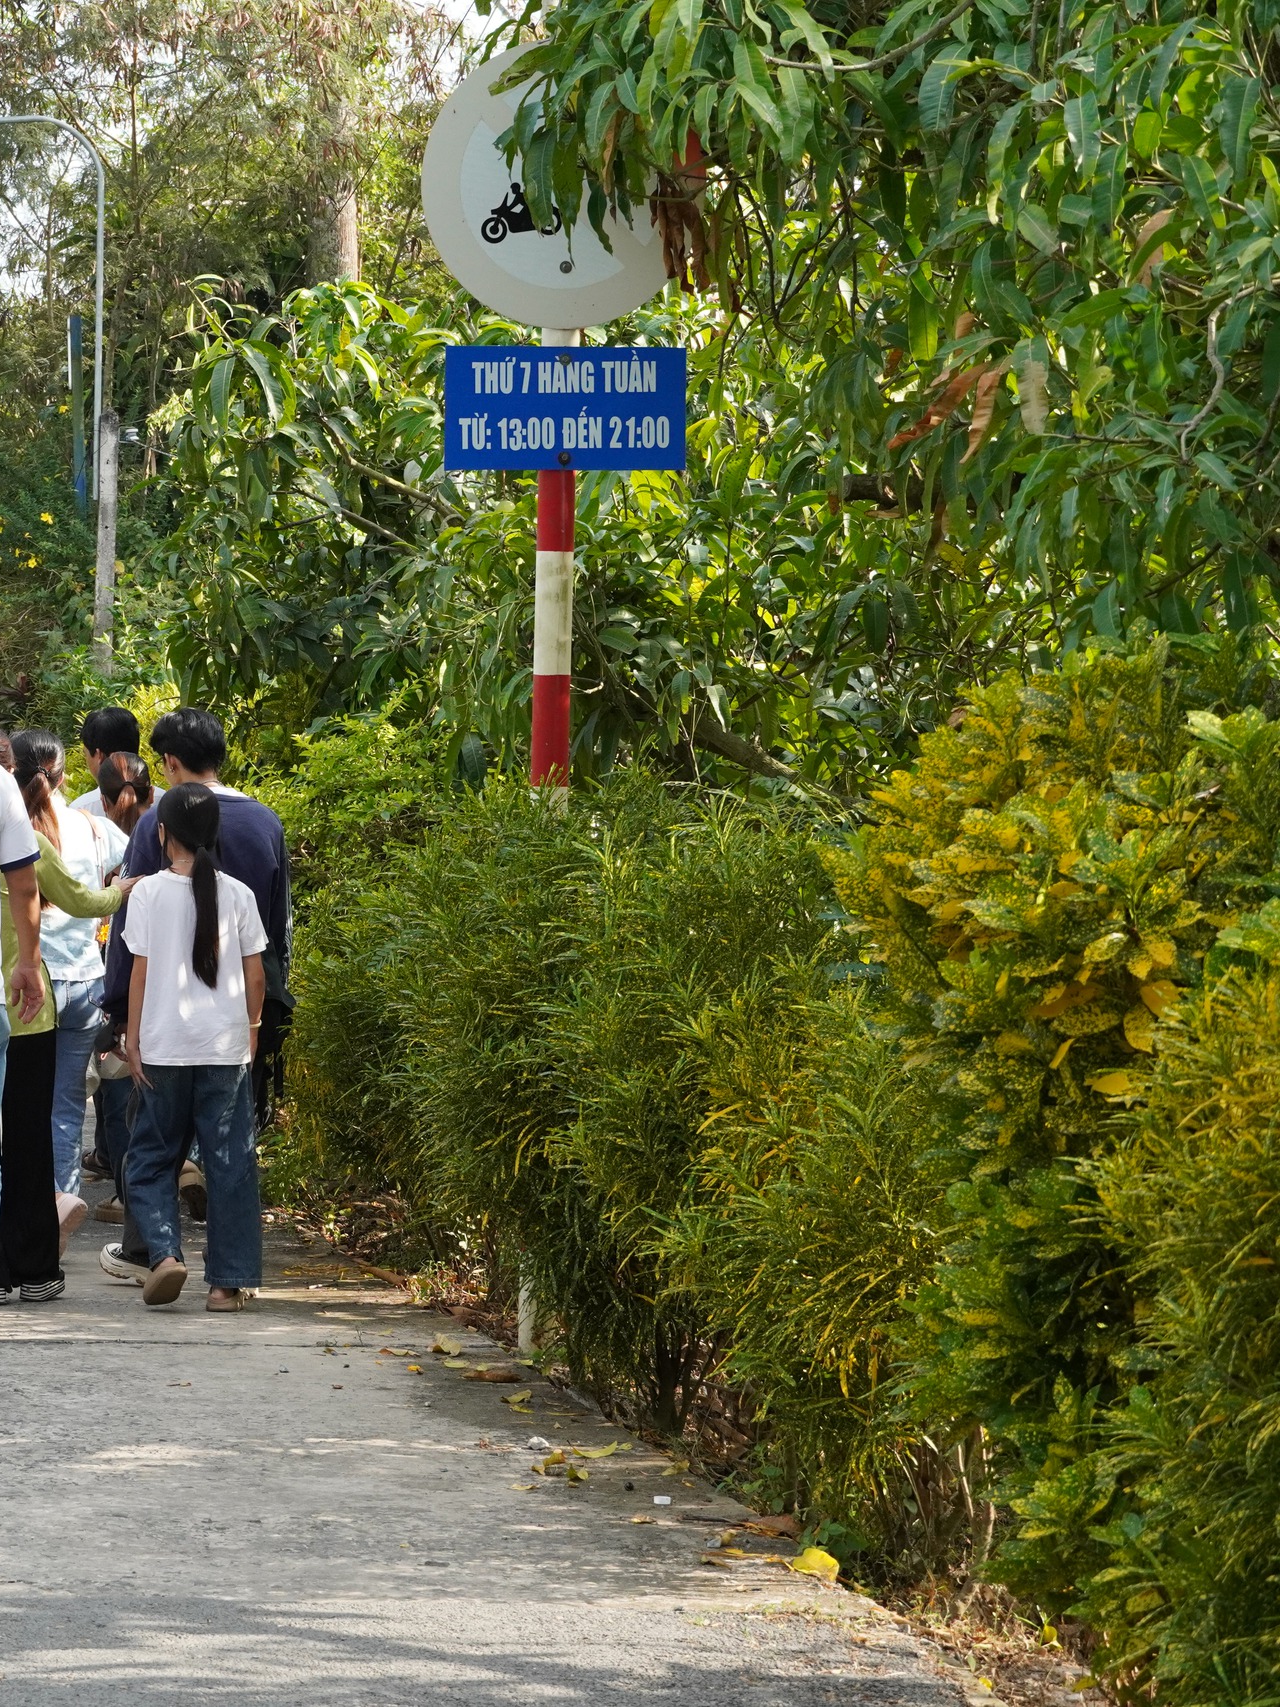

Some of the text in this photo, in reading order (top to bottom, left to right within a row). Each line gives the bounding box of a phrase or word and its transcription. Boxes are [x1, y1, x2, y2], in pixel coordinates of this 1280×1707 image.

[471, 350, 657, 394] THỨ 7 HÀNG TUẦN
[459, 406, 670, 451] TỪ: 13:00 ĐẾN 21:00
